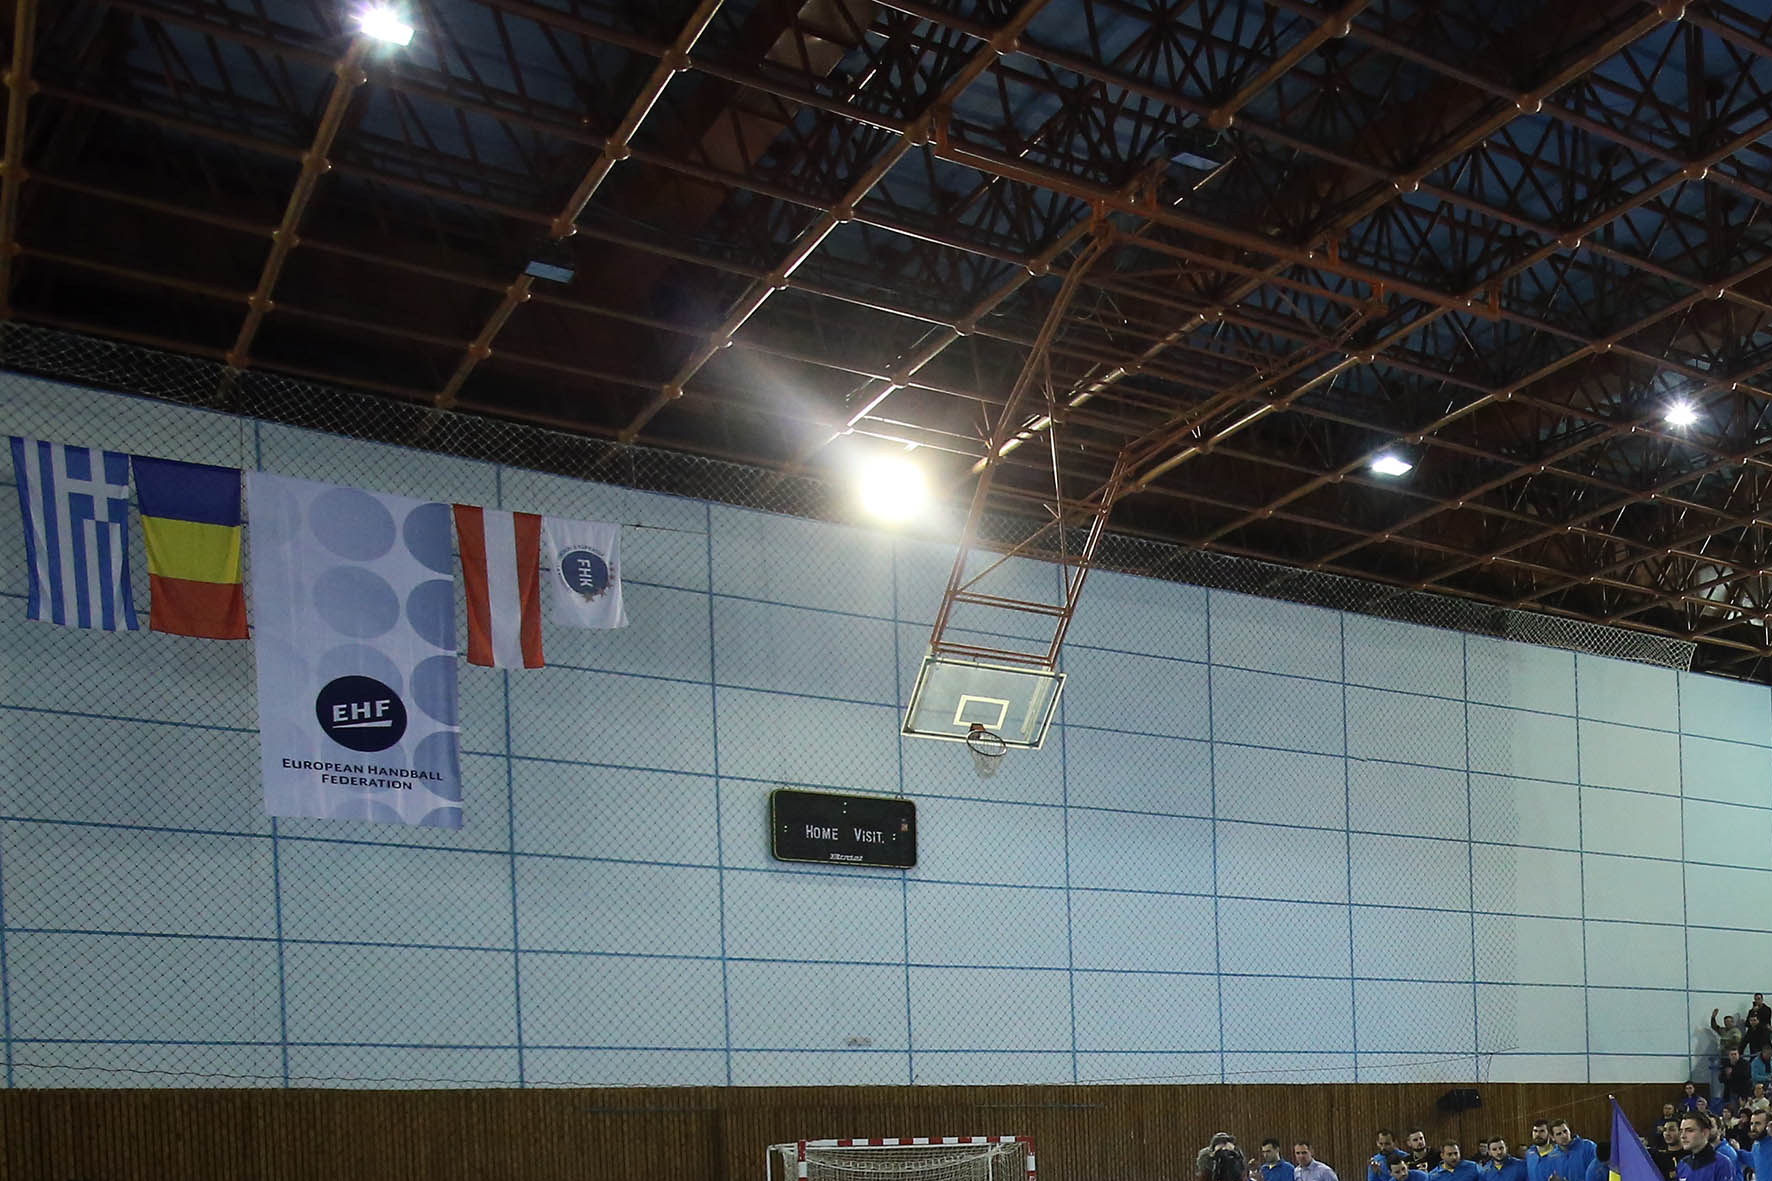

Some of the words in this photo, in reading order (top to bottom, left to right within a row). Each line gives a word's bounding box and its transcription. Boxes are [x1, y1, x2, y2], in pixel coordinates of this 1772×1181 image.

[332, 700, 391, 722] EHF
[282, 758, 364, 774] EUROPEAN
[367, 765, 444, 782] HANDBALL
[321, 774, 413, 790] FEDERATION
[805, 824, 839, 841] HOME
